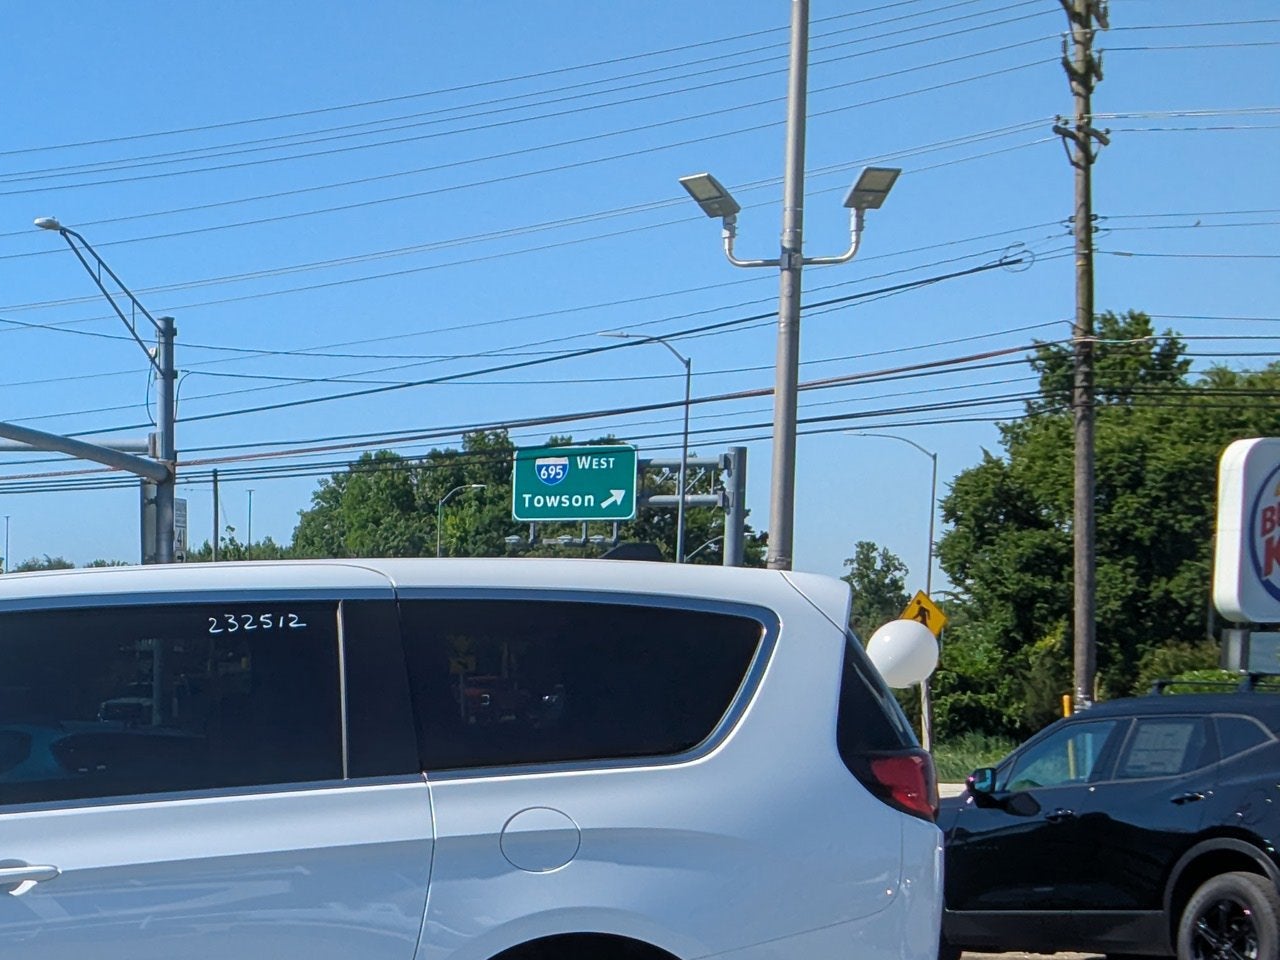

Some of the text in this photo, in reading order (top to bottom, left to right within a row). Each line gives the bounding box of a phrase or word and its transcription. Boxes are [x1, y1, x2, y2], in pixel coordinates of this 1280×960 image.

[540, 456, 615, 479] 695 WEST
[522, 494, 595, 508] Towson
[208, 613, 307, 633] 232512
